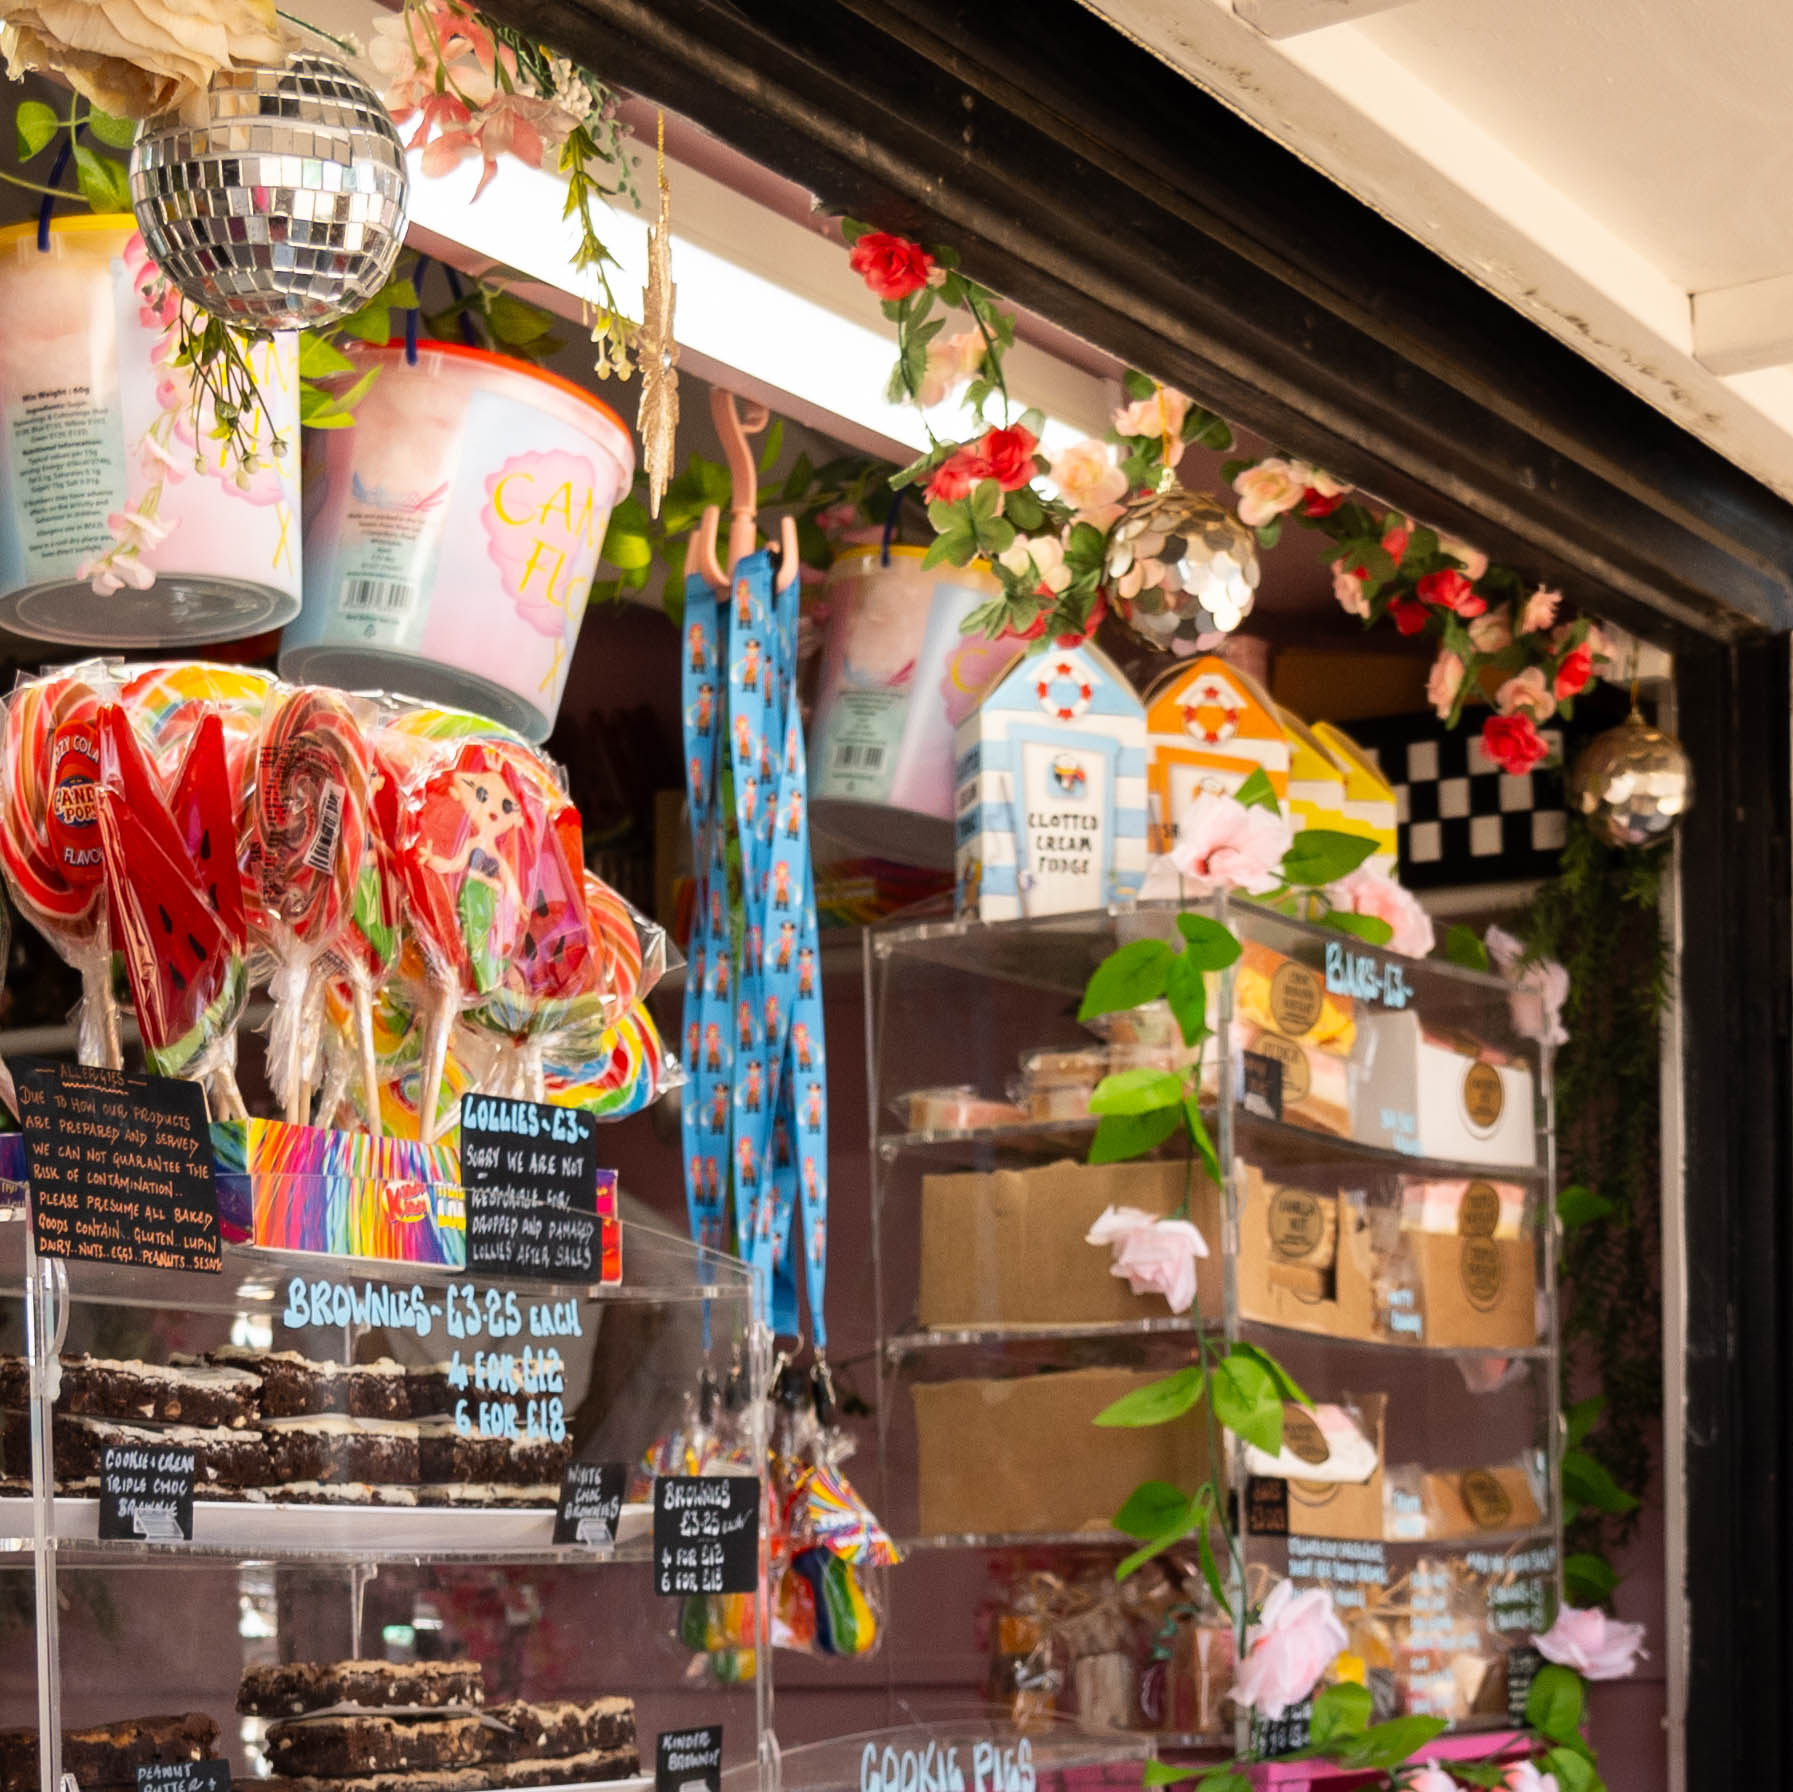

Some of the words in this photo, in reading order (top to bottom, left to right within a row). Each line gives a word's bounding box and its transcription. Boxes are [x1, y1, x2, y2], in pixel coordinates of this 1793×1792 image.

[73, 735, 100, 763] COLA
[1028, 812, 1100, 831] CLOTTED
[1036, 836, 1093, 853] CREAM
[1038, 857, 1090, 875] FUDGE
[60, 1064, 125, 1086] ALLERGIES
[72, 1097, 96, 1115] HOW
[103, 1103, 128, 1120] OUR
[134, 1106, 191, 1131] PRODUCTS
[463, 1095, 540, 1138] LOLLIES
[25, 1115, 51, 1130] ARE
[59, 1119, 120, 1146] PREPARED
[124, 1130, 148, 1148] AND
[155, 1133, 200, 1158] SERVED
[33, 1143, 50, 1156] WE
[58, 1145, 81, 1161] CAN
[87, 1150, 106, 1164] NOT
[113, 1152, 181, 1174] GUARANTEE
[186, 1162, 209, 1179] THE
[33, 1164, 60, 1180] RISK
[67, 1169, 79, 1182] OF
[508, 1152, 524, 1173] WE
[529, 1152, 557, 1174] ARE
[562, 1156, 584, 1178] NOT
[39, 1192, 79, 1209] PLEASE
[87, 1196, 140, 1221] PRESUME
[145, 1206, 166, 1223] ALL
[174, 1208, 213, 1231] BAKED
[39, 1213, 69, 1235] GOODS
[183, 1236, 217, 1254] LUPIN
[472, 1215, 517, 1239] DROPPED
[522, 1215, 543, 1240] AND
[549, 1220, 595, 1244] DAMAGED
[473, 1243, 512, 1261] LOLLIES
[516, 1245, 551, 1269] AFTER
[554, 1247, 592, 1270] SALES
[529, 1298, 583, 1337] EACH
[448, 1350, 468, 1391] 4
[474, 1351, 519, 1396] FOR
[522, 1345, 564, 1393] £12
[455, 1399, 471, 1437] 6
[479, 1401, 521, 1441] FOR
[526, 1397, 566, 1443] £18
[105, 1449, 148, 1470] COOKIE
[158, 1452, 195, 1473] CREAM
[107, 1473, 147, 1494] TRIPLE
[153, 1478, 187, 1497] CHOC
[568, 1465, 602, 1485] WHITE
[576, 1487, 601, 1504] CHOC
[663, 1480, 731, 1510] BROWNIES
[564, 1496, 619, 1520] BROWNIES
[661, 1548, 672, 1568] 4
[676, 1548, 697, 1567] FOR
[701, 1543, 724, 1566] £12
[661, 1569, 670, 1592] 6
[676, 1571, 698, 1592] FOR
[663, 1731, 711, 1751] KINDER
[138, 1763, 193, 1782] PEANUT
